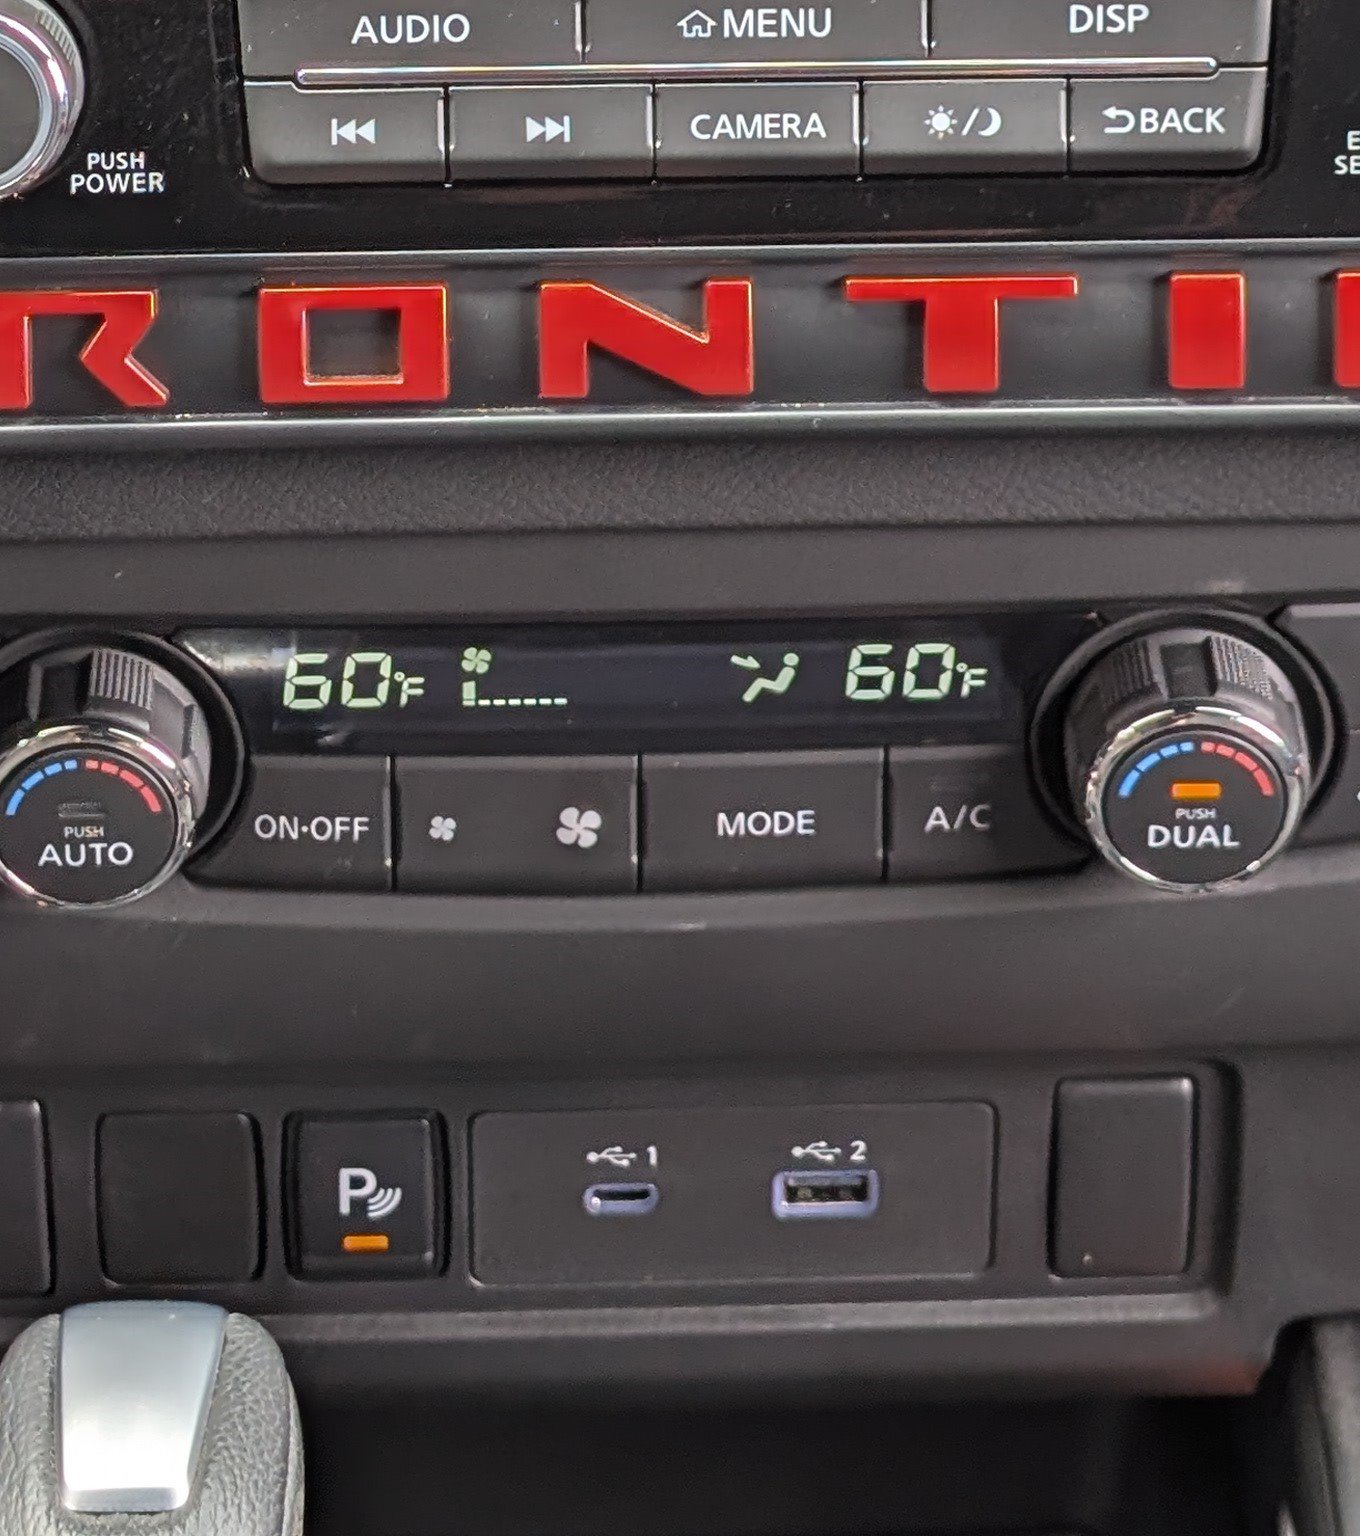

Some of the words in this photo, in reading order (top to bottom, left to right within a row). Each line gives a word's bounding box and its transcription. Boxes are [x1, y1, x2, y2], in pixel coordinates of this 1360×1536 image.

[350, 12, 472, 46] AUDIO
[722, 7, 833, 41] MENU
[1068, 3, 1150, 34] DISP
[689, 112, 827, 141] CAMERA
[1140, 107, 1226, 136] BACK
[86, 151, 145, 171] PUSH
[69, 172, 166, 195] POWER
[716, 809, 817, 837] MODE
[923, 803, 993, 833] A/C
[1174, 807, 1217, 820] PUSH
[63, 824, 105, 839] PUSH
[1146, 823, 1241, 849] DUAL
[38, 841, 134, 866] AUTO
[645, 1144, 659, 1167] 1
[849, 1138, 868, 1162] 2
